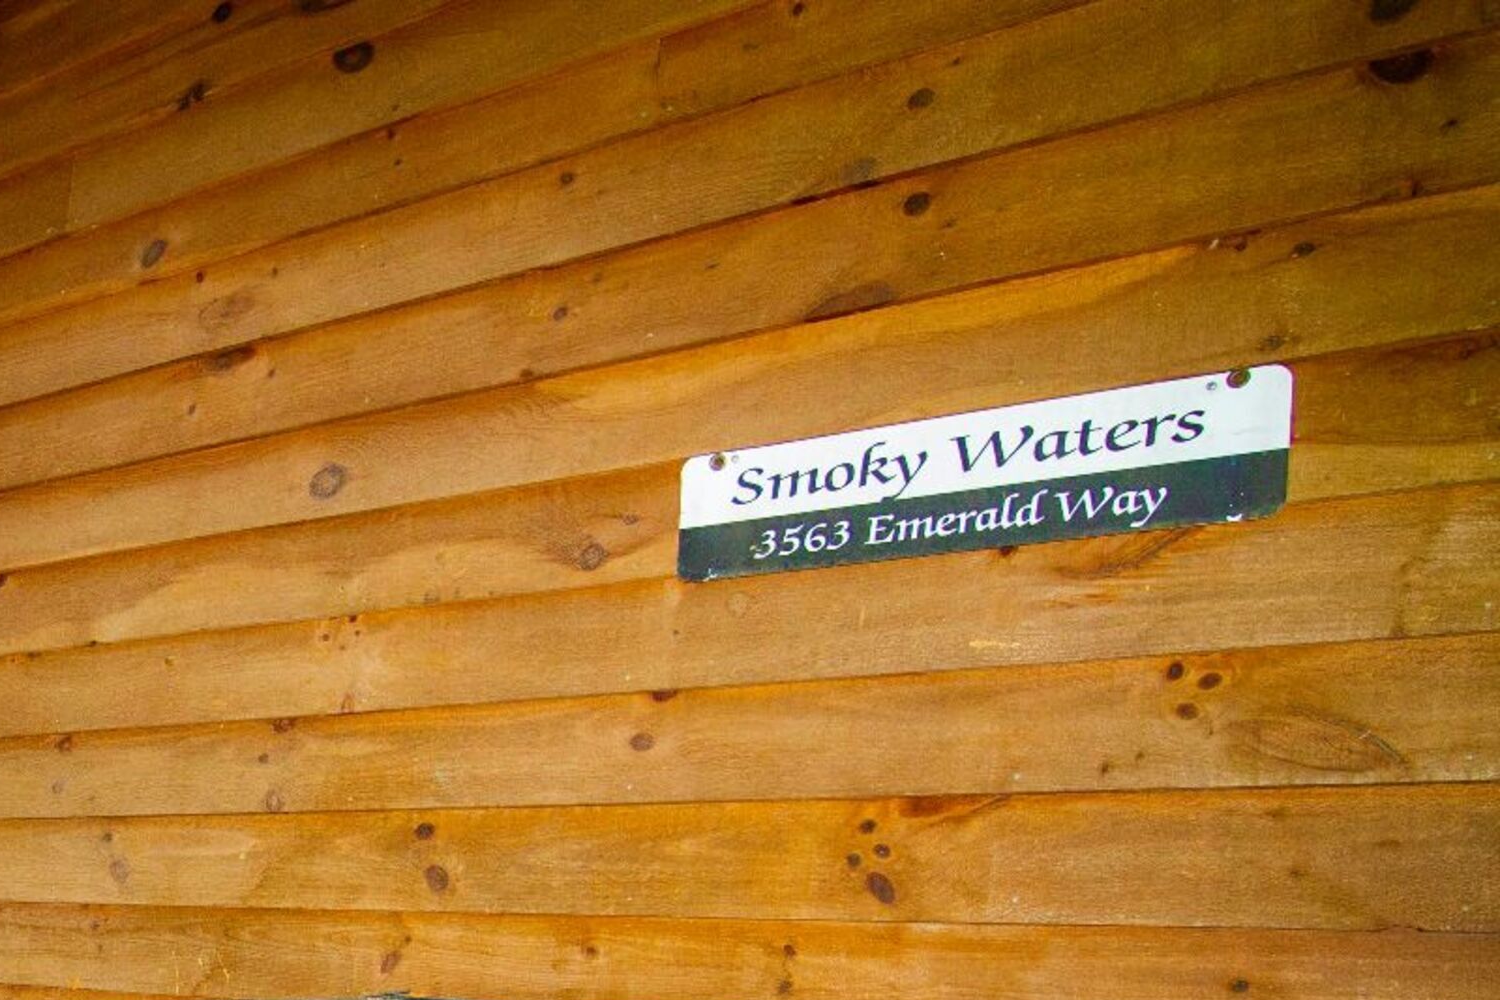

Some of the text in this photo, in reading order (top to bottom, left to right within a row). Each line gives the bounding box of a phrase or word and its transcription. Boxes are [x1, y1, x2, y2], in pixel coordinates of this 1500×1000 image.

[731, 409, 1206, 506] Smoky Waters
[752, 486, 1168, 560] 3563 Emerald Way
